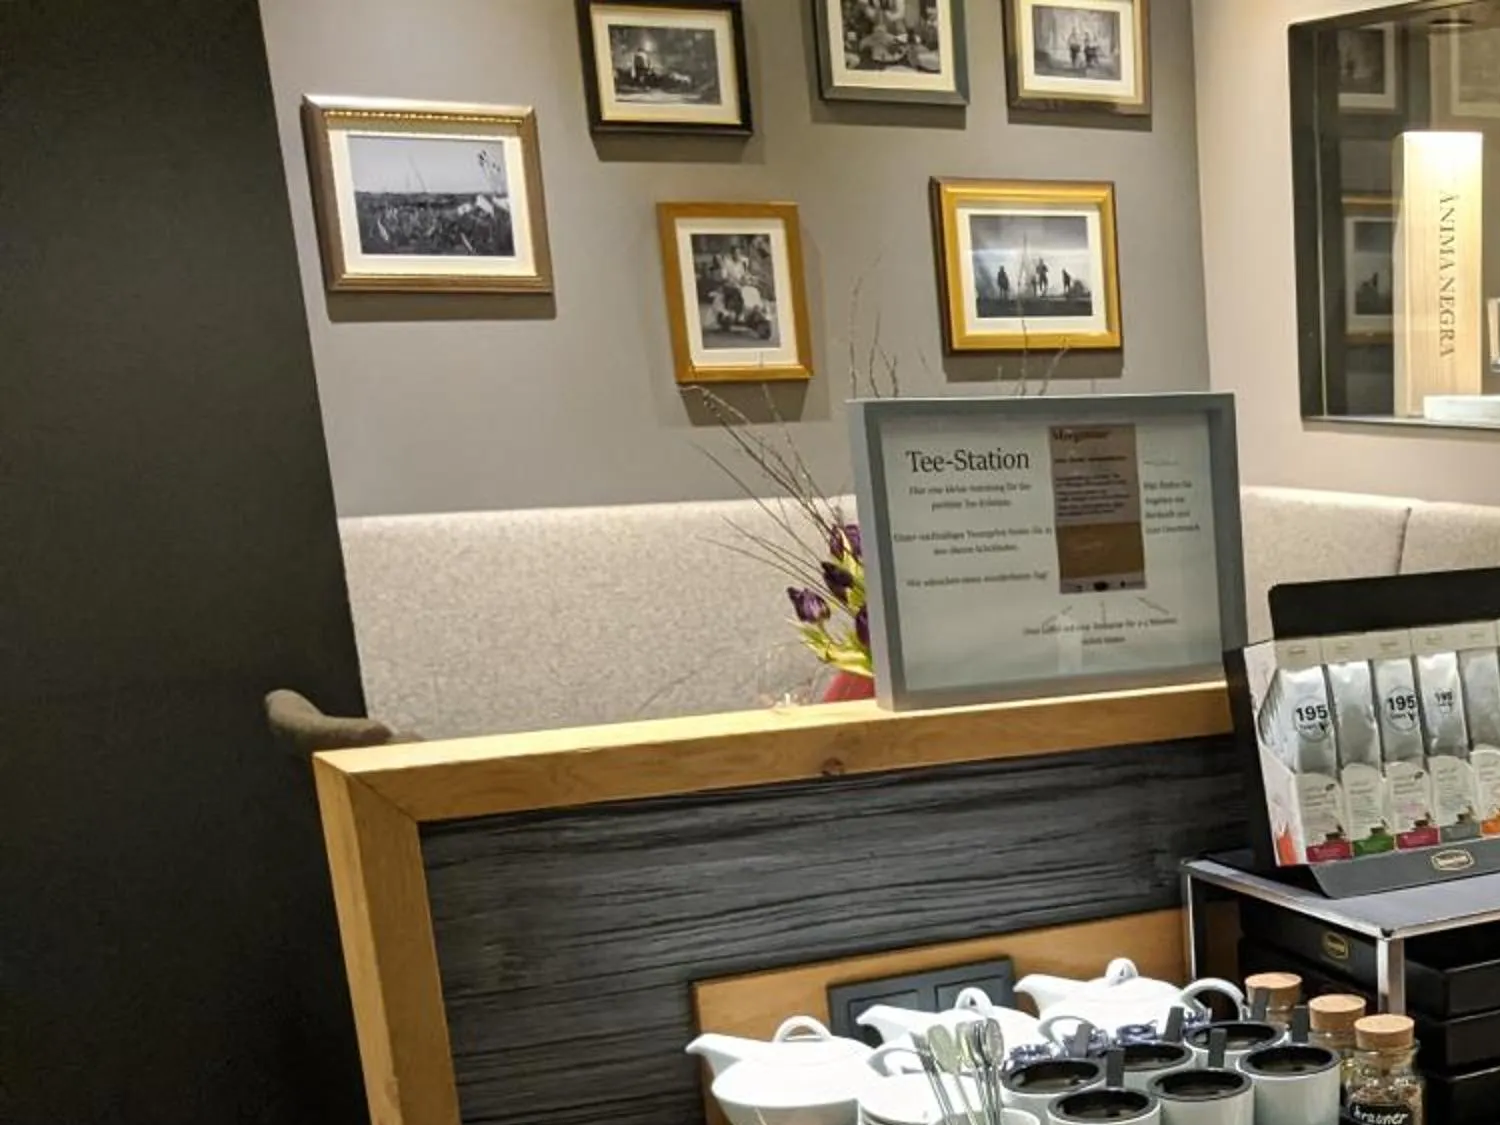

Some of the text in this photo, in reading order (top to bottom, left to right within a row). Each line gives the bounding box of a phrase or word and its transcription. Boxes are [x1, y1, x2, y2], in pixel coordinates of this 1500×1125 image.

[1439, 276, 1456, 358] NEGRA
[905, 448, 1030, 473] Tee-Station
[1295, 704, 1328, 722] 195
[1386, 695, 1416, 711] 195
